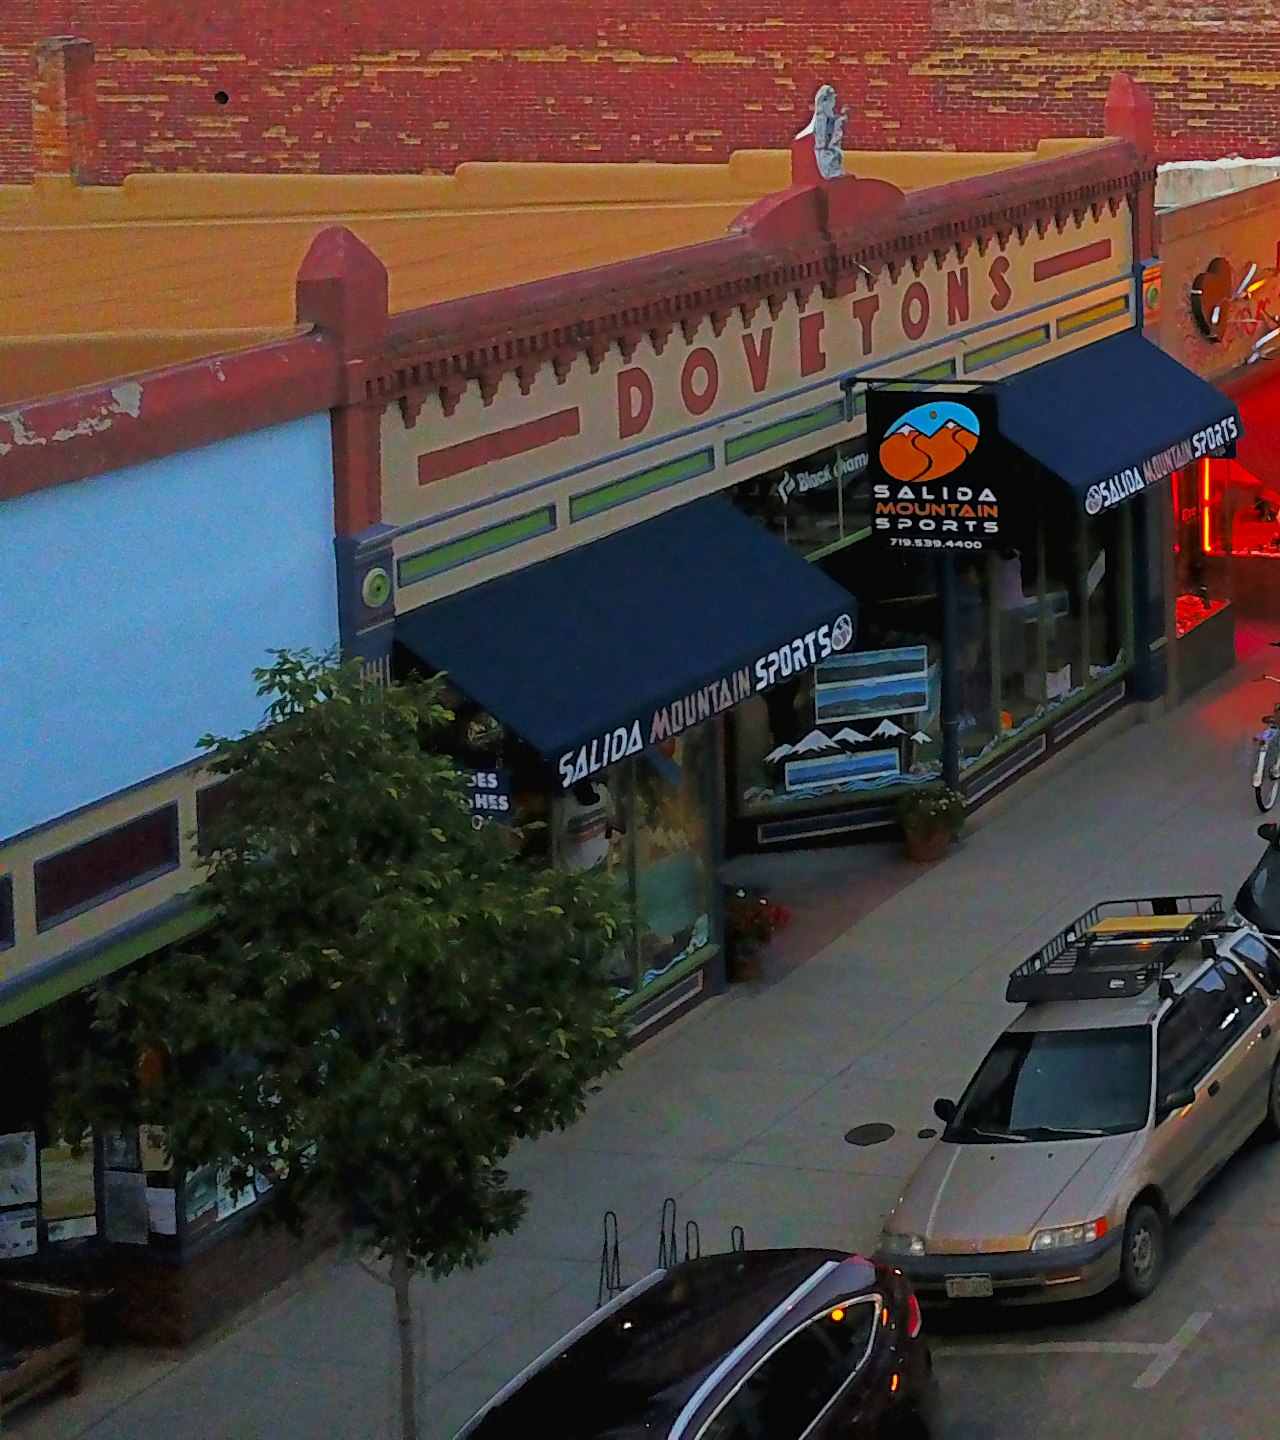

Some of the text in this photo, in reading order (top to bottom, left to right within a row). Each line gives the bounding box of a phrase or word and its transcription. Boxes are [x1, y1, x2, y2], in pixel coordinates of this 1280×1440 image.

[618, 256, 1012, 439] DOVETONS
[1099, 415, 1238, 507] SALIDA MOUNTAIN SPORTS
[796, 464, 832, 492] Black
[873, 484, 997, 502] SALIDA
[875, 501, 998, 518] MOUNTAIN
[875, 517, 999, 533] SPORTS
[890, 537, 982, 549] 719.539.4400
[558, 624, 832, 789] SALIDA MOUNTAIN SPORTS
